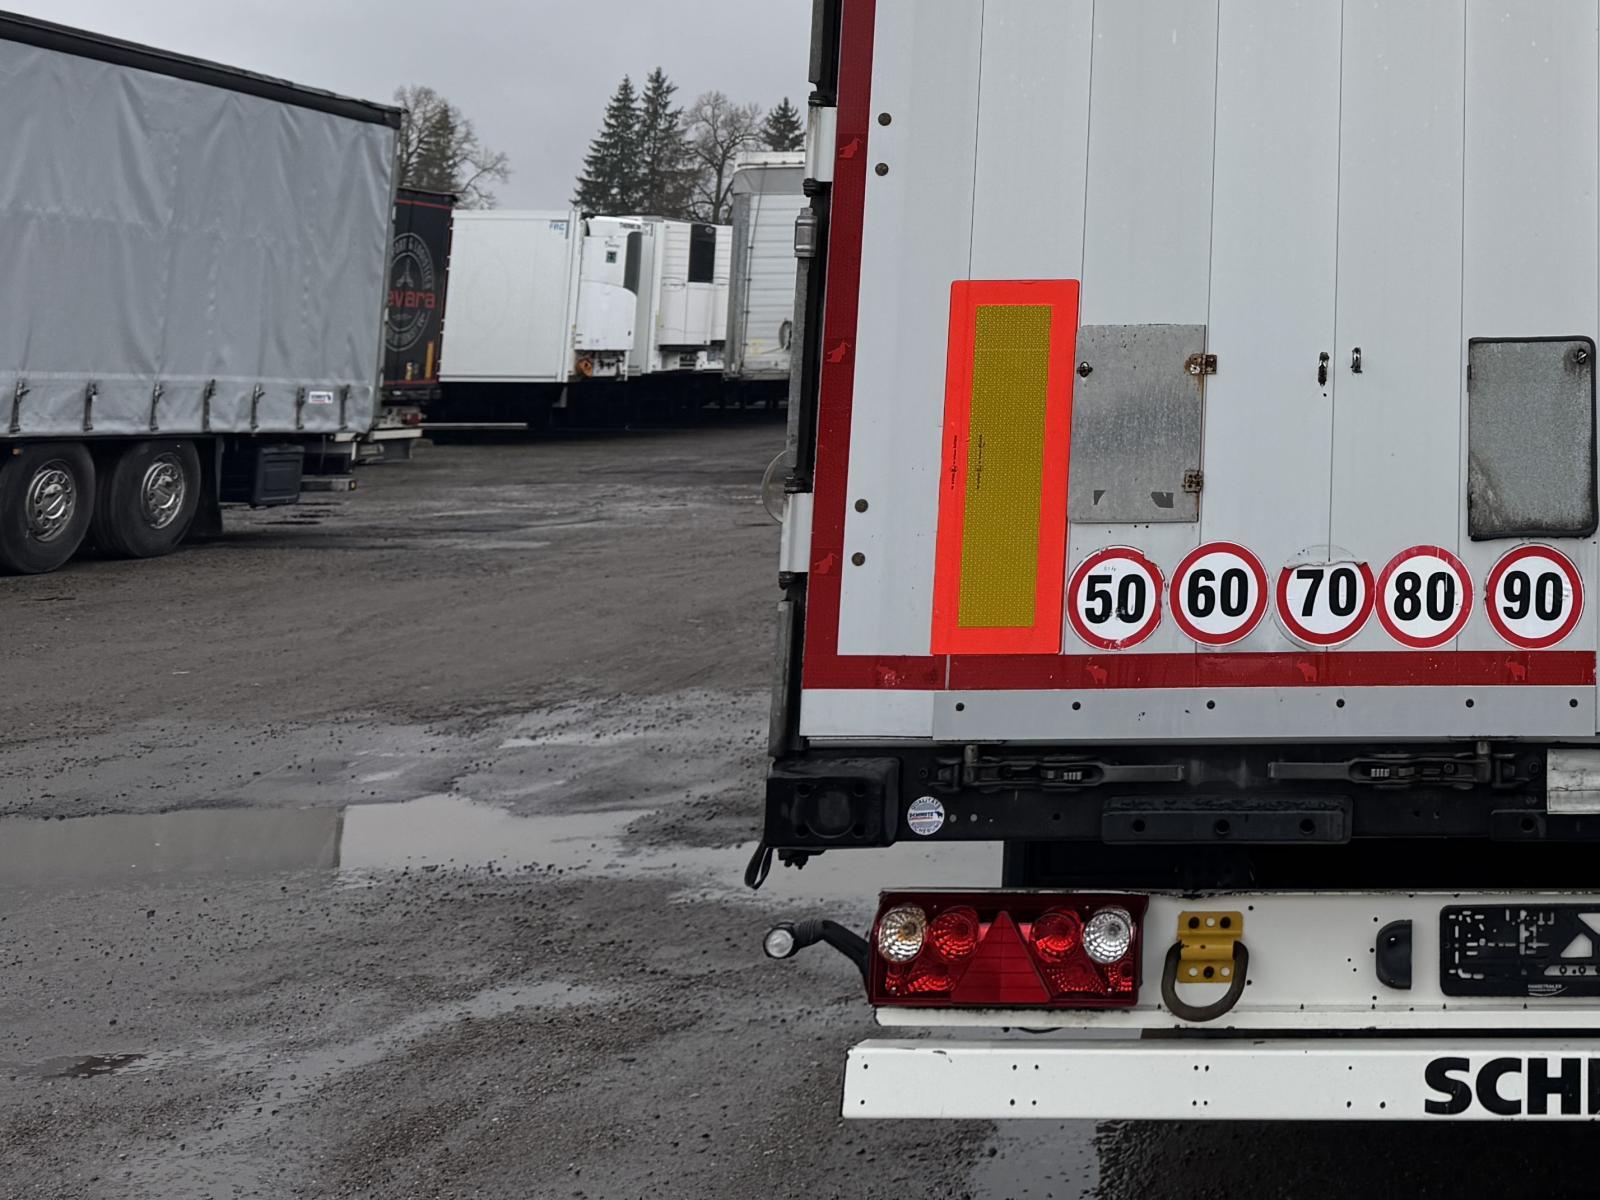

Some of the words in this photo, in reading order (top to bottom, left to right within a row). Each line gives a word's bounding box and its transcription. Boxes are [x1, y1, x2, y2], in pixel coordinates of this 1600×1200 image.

[1084, 574, 1147, 624] 50
[1187, 568, 1249, 618] 60
[1296, 568, 1357, 617] 70
[1394, 571, 1456, 621] 80
[1503, 571, 1563, 621] 90
